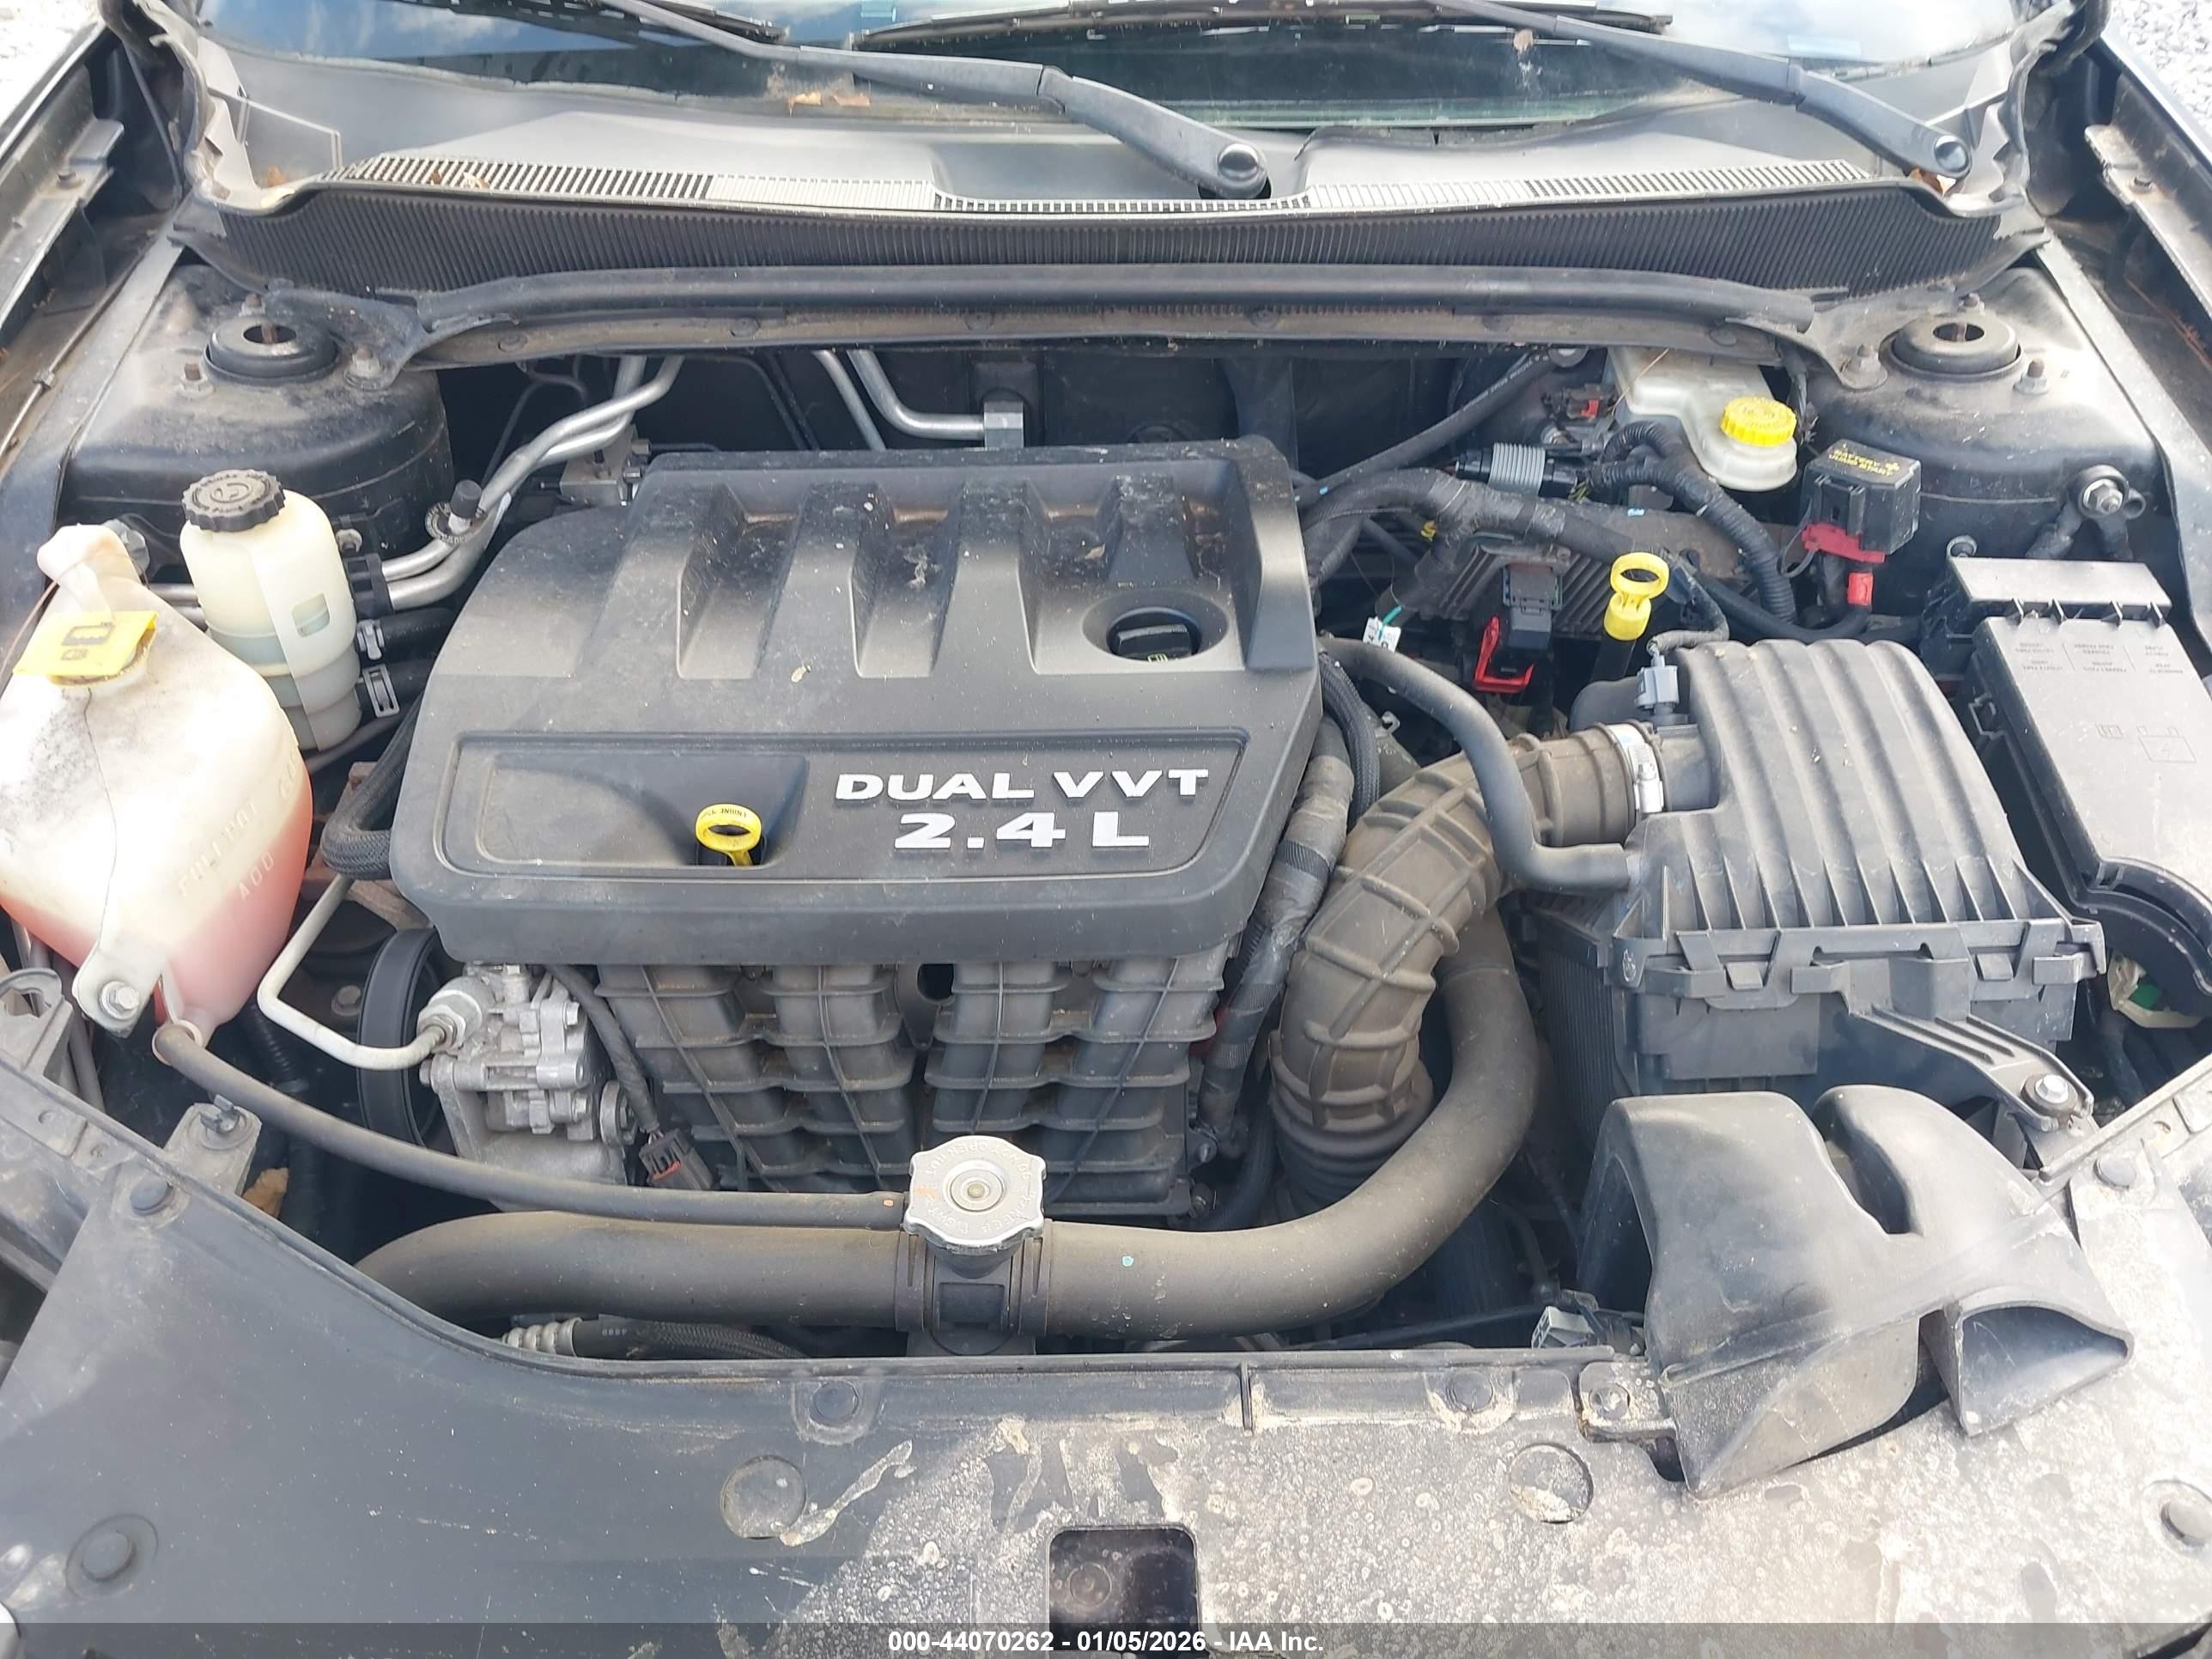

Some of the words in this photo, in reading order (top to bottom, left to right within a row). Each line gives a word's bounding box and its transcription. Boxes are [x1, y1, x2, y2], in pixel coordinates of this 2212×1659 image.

[835, 772, 1036, 800] DUAL
[1053, 769, 1210, 799] VVT
[238, 851, 275, 900] ADD
[947, 1140, 989, 1155] OPEN
